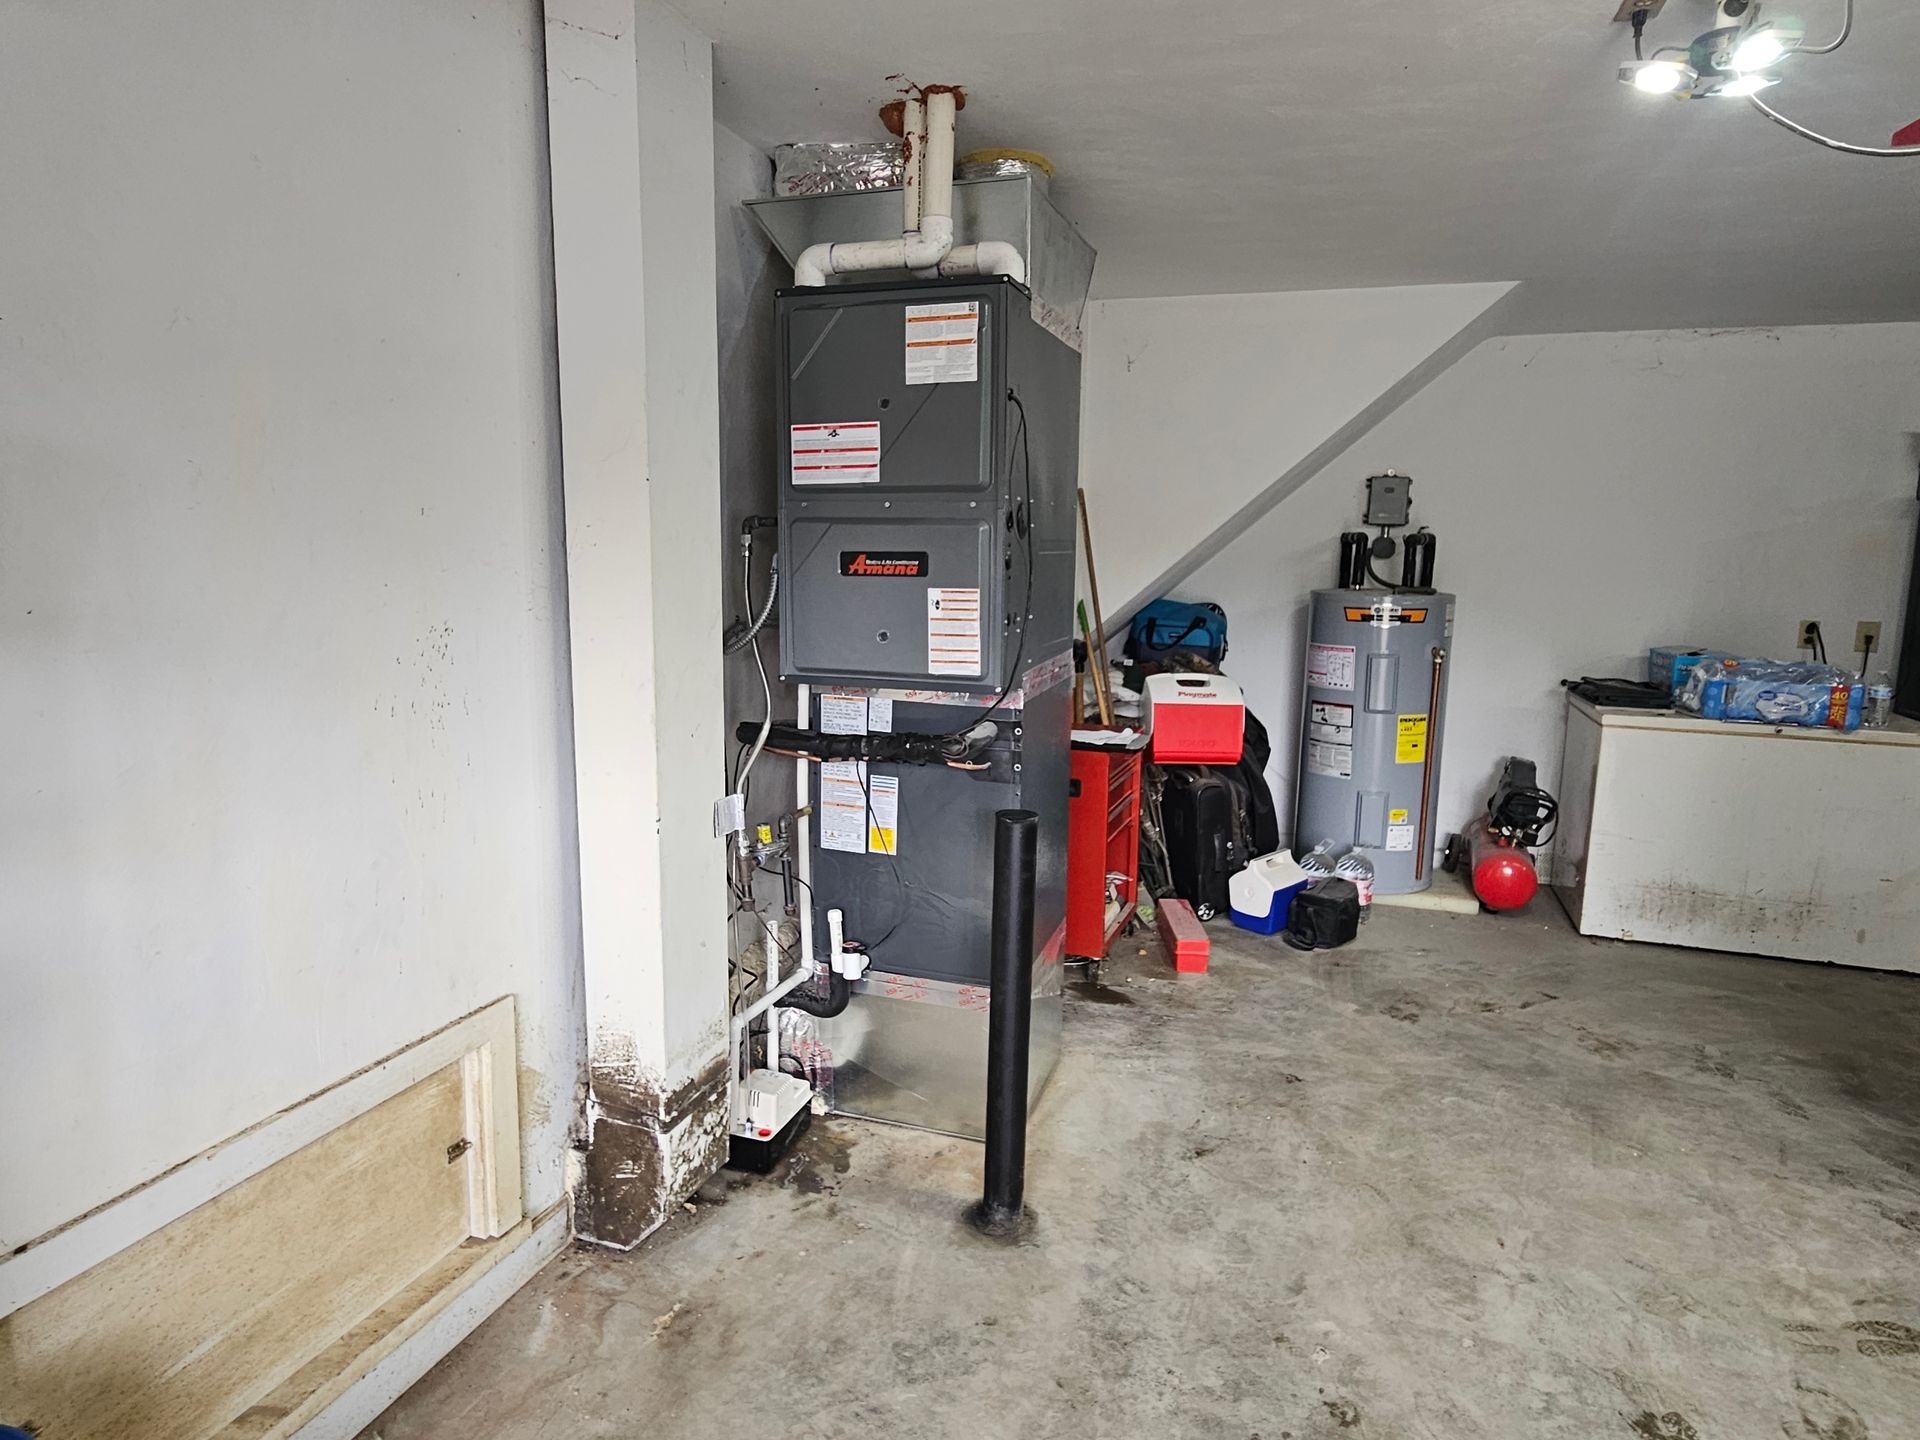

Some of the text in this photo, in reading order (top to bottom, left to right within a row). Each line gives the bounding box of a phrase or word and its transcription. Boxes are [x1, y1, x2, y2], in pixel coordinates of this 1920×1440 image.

[848, 554, 918, 575] Amana
[1178, 691, 1217, 699] Playmate
[1831, 691, 1848, 700] 40
